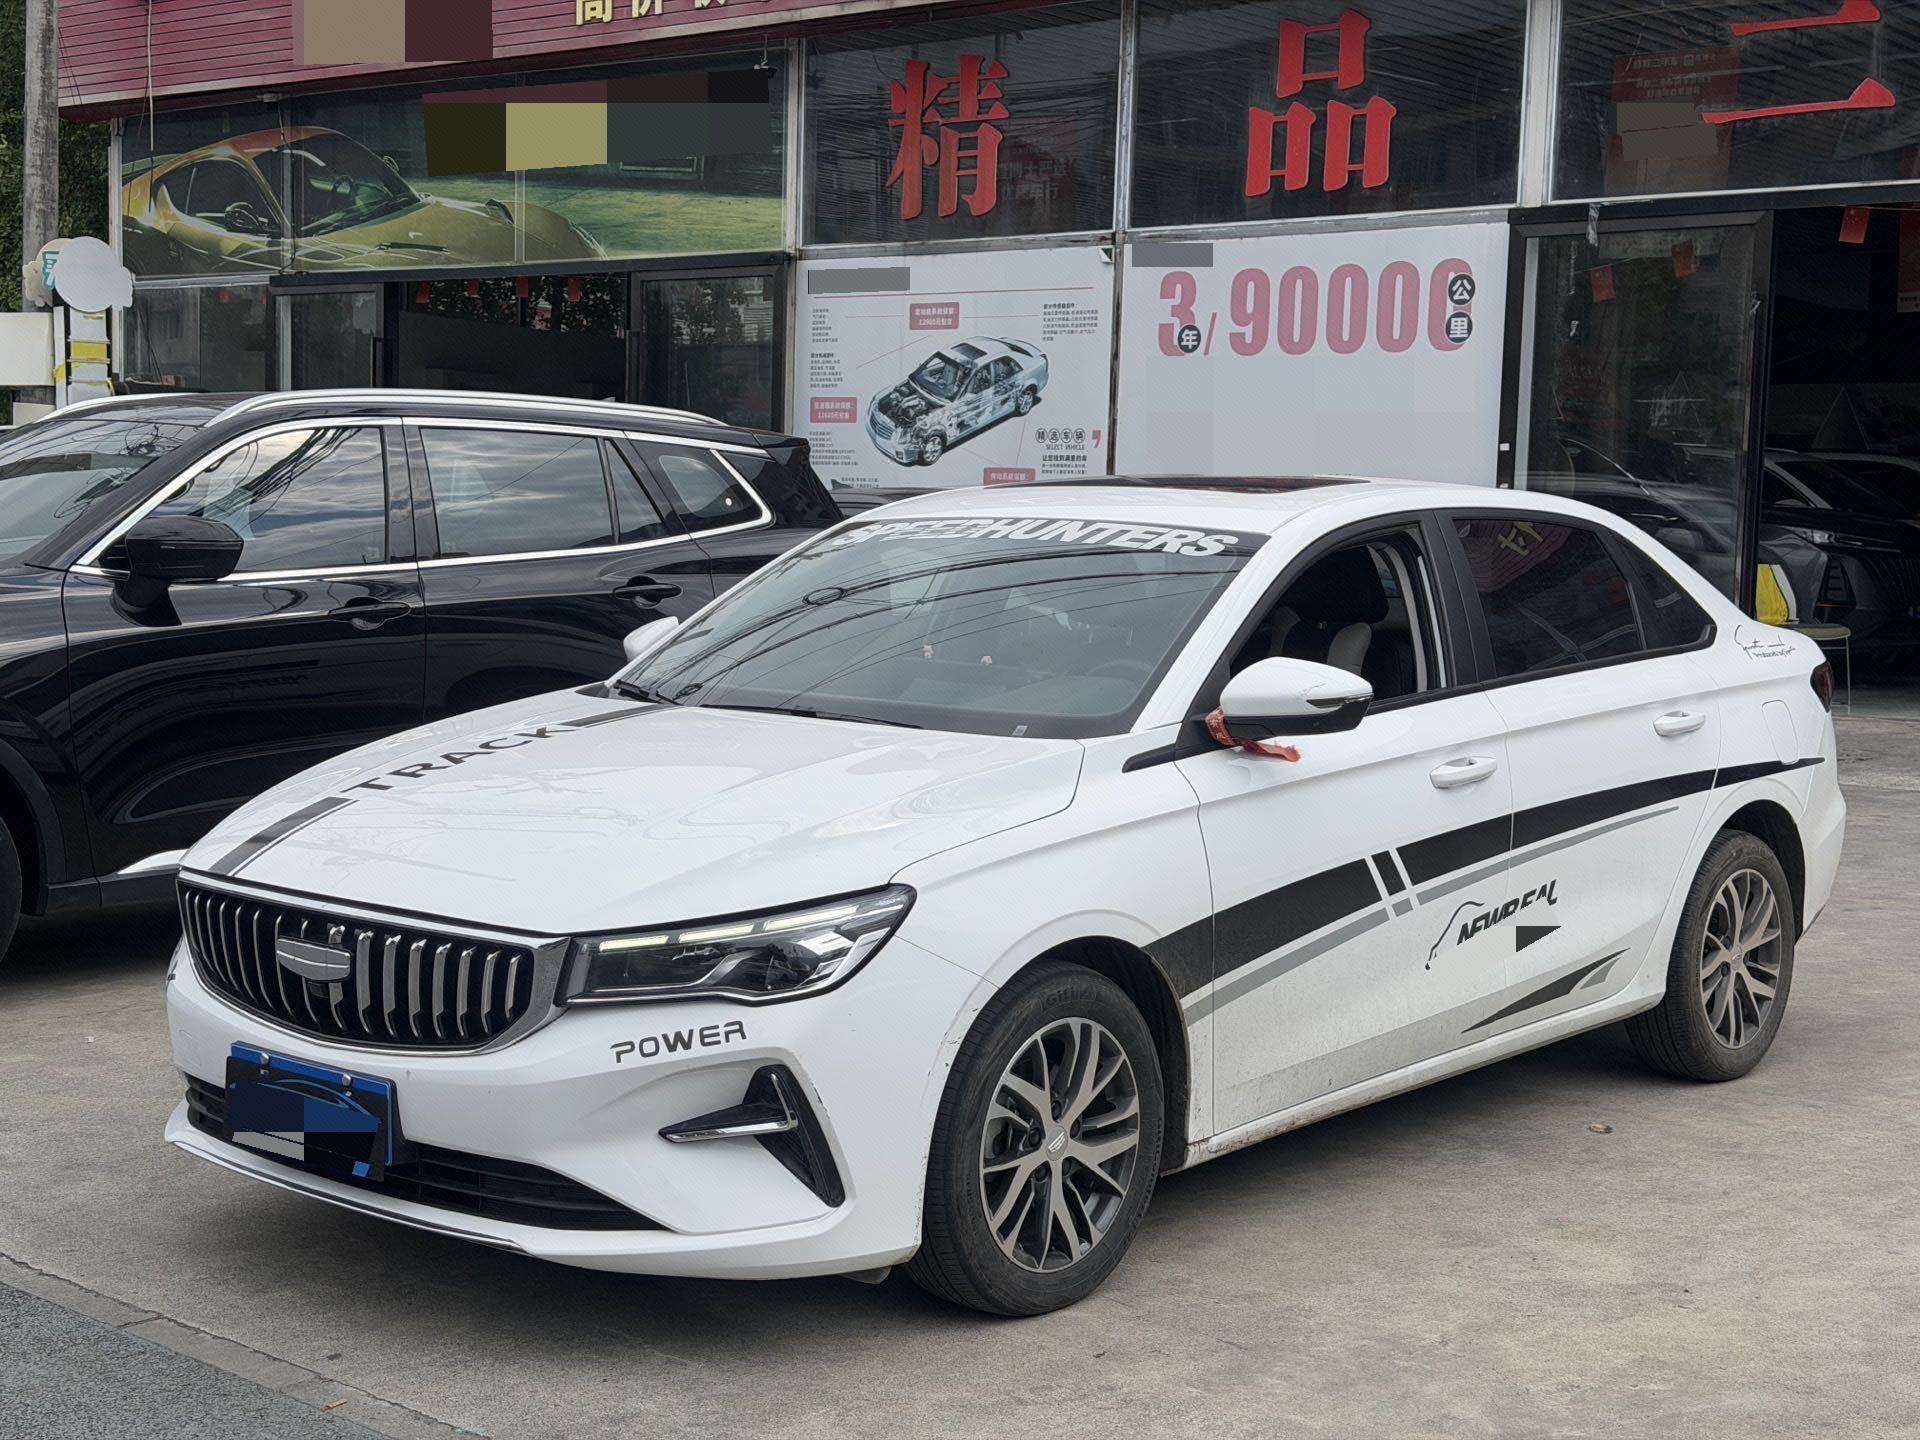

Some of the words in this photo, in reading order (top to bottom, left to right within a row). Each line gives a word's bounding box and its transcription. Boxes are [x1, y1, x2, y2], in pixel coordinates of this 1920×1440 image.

[1035, 427, 1087, 444] 精选车辆
[831, 519, 1240, 556] SPEEDHUNTERS
[339, 726, 577, 793] TRACK
[610, 1020, 747, 1064] POWER
